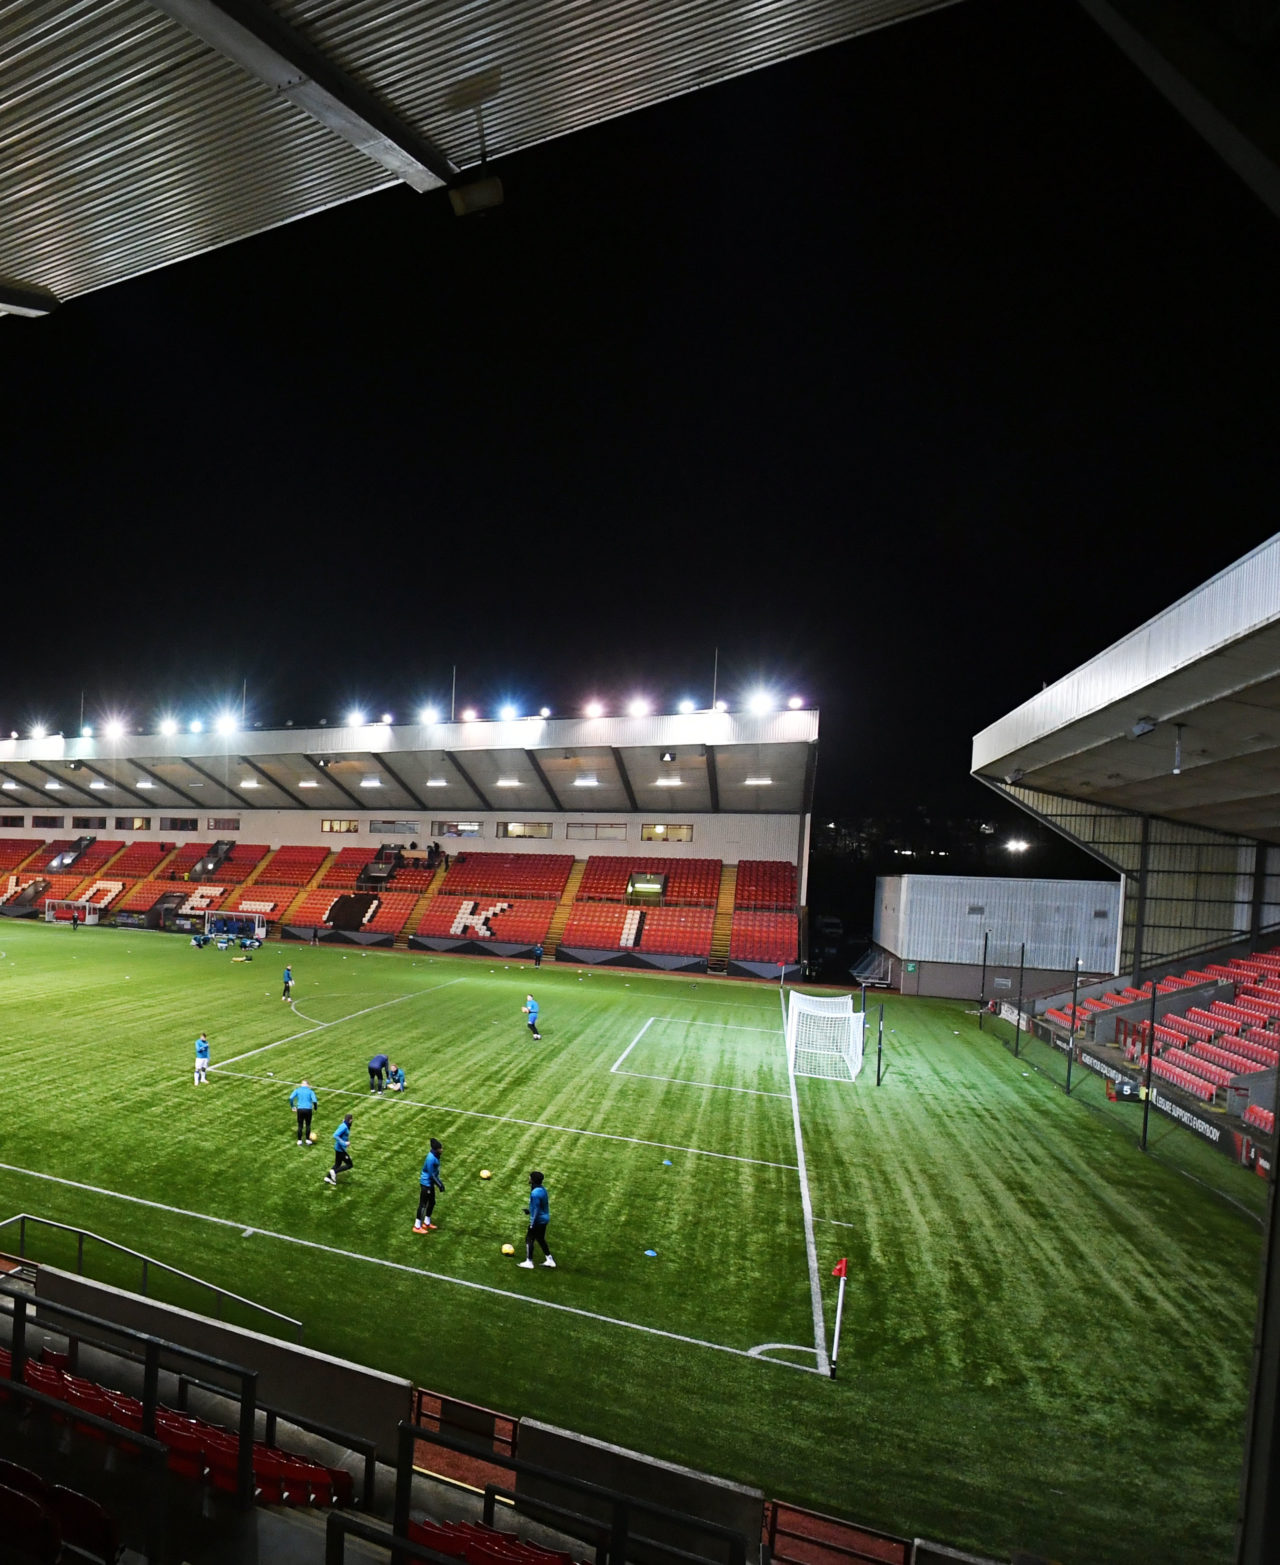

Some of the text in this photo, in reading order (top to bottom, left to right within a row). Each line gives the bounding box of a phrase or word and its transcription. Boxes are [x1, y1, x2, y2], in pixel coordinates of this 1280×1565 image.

[1122, 1085, 1131, 1095] 5
[1156, 1095, 1172, 1114] LEISURE
[1171, 1104, 1193, 1127] SUPPORTS
[1192, 1116, 1221, 1143] EVERYBODY
